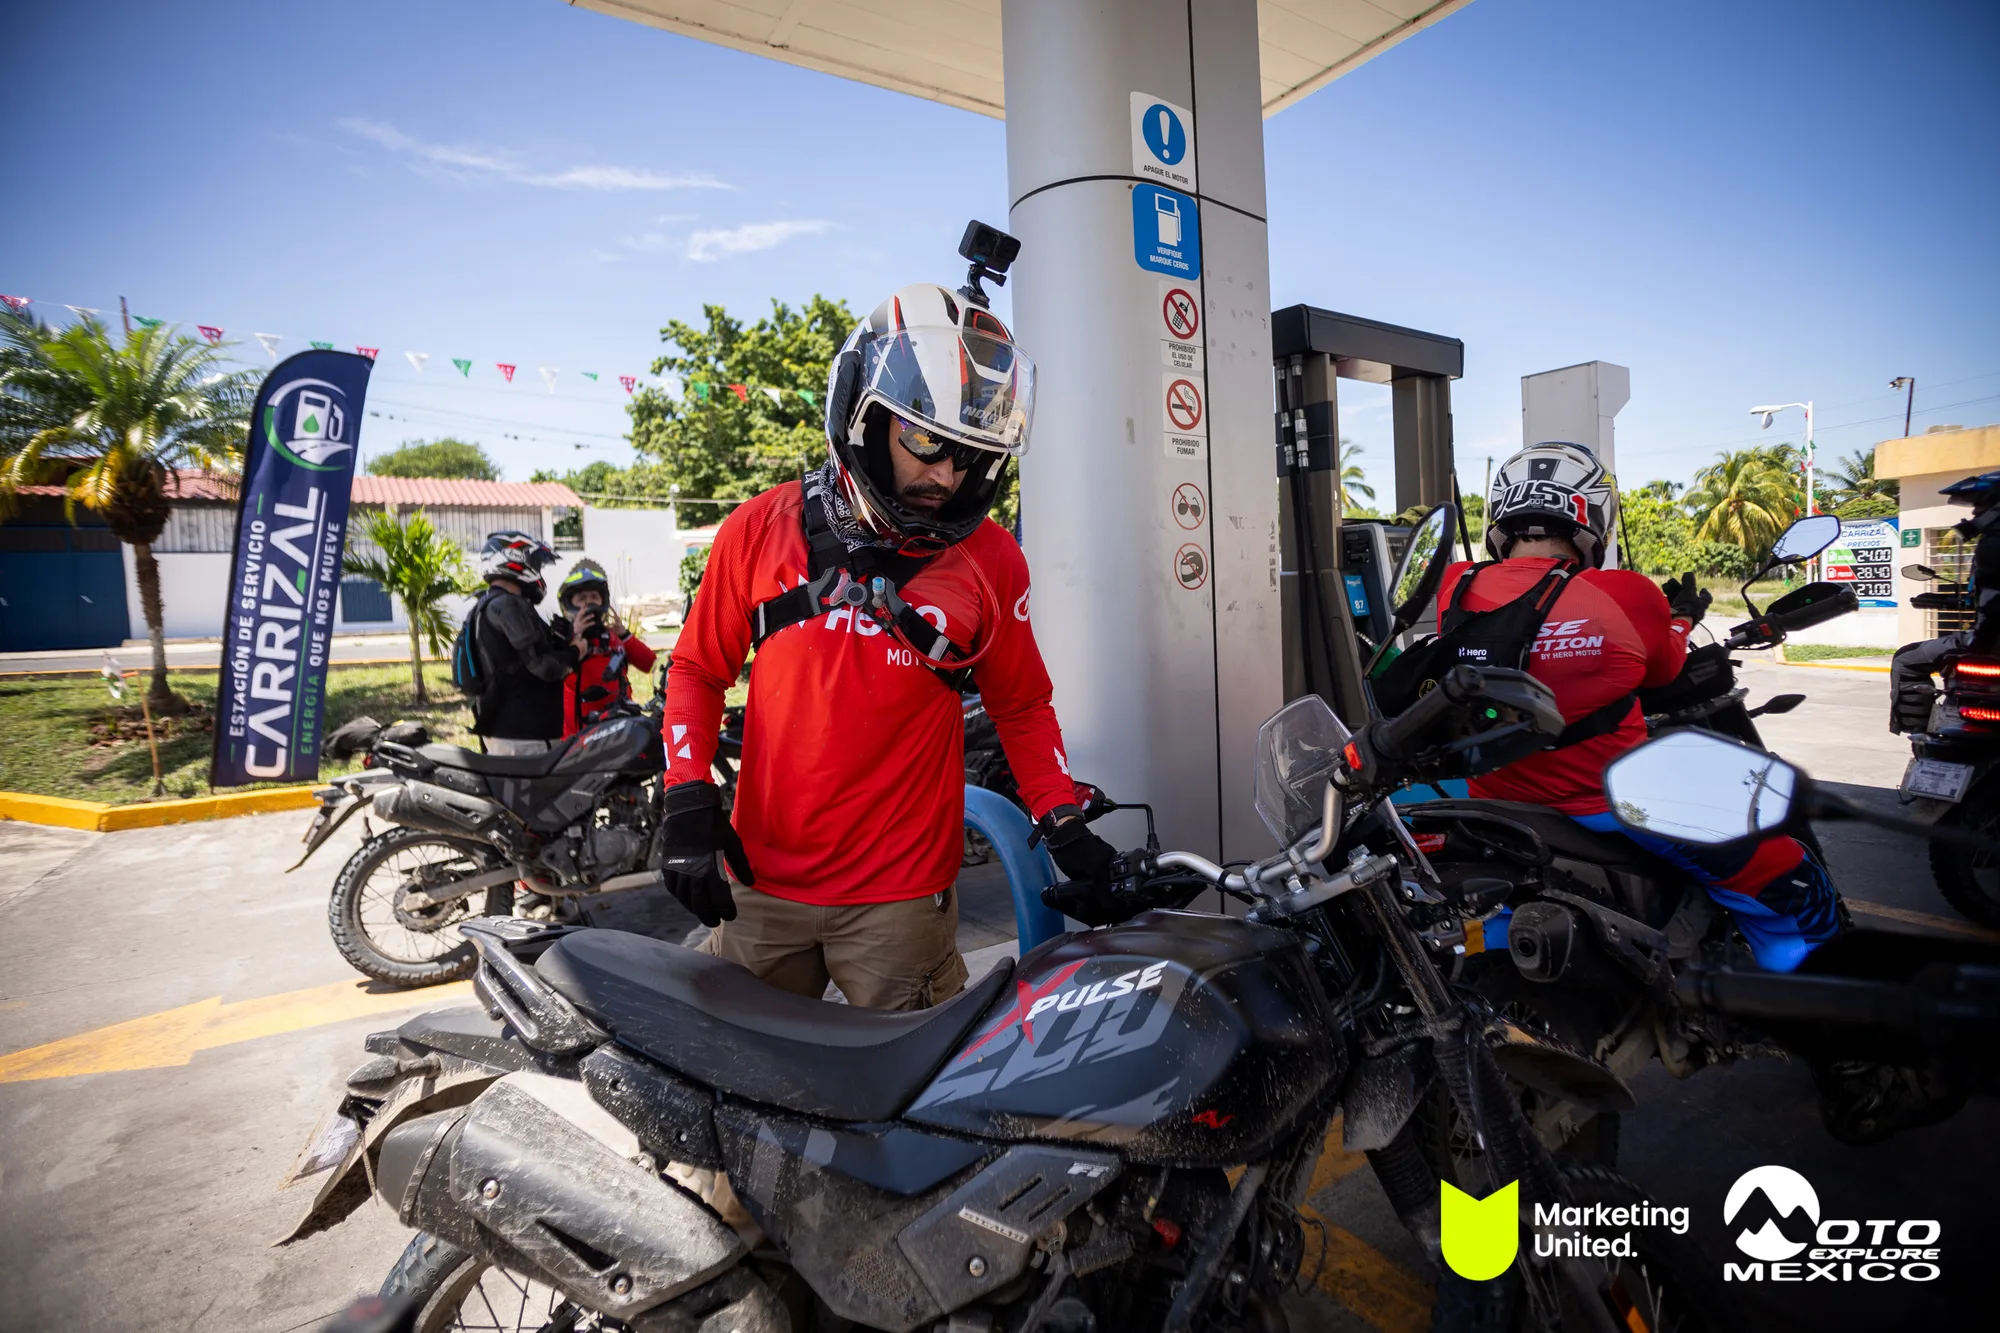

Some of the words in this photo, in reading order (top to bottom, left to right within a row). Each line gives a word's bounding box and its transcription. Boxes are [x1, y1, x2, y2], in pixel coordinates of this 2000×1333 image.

[1143, 165, 1164, 176] APAGUE
[1172, 173, 1188, 184] MOTOR
[1157, 247, 1182, 259] VERIFIQUE
[1150, 254, 1172, 266] MARQUE
[1173, 259, 1189, 271] CEROS
[1168, 342, 1196, 354] PROHIBIDO
[1178, 353, 1187, 361] USO
[1188, 354, 1194, 362] DE
[1173, 359, 1193, 369] CELULAR
[1172, 437, 1200, 448] PROHIBIDO
[1177, 446, 1196, 456] FUMAR
[1841, 529, 1886, 537] CARRIZAL
[321, 521, 341, 580] MUEVE
[1857, 549, 1891, 562] 24.00
[242, 521, 266, 608] SERVICIO
[1857, 567, 1890, 579] 28.40
[1857, 584, 1891, 596] 27.00
[315, 587, 331, 625] NOS
[1354, 600, 1364, 610] 87
[825, 604, 947, 637] Heo
[238, 616, 254, 642] DE
[244, 487, 320, 778] CARRIZAL
[310, 631, 326, 667] QUE
[1467, 648, 1487, 656] Hero
[1553, 650, 1574, 659] HERO
[1575, 649, 1602, 657] MOTOS
[229, 650, 250, 738] ESTACIÓN
[300, 673, 320, 755] ENERGÍA
